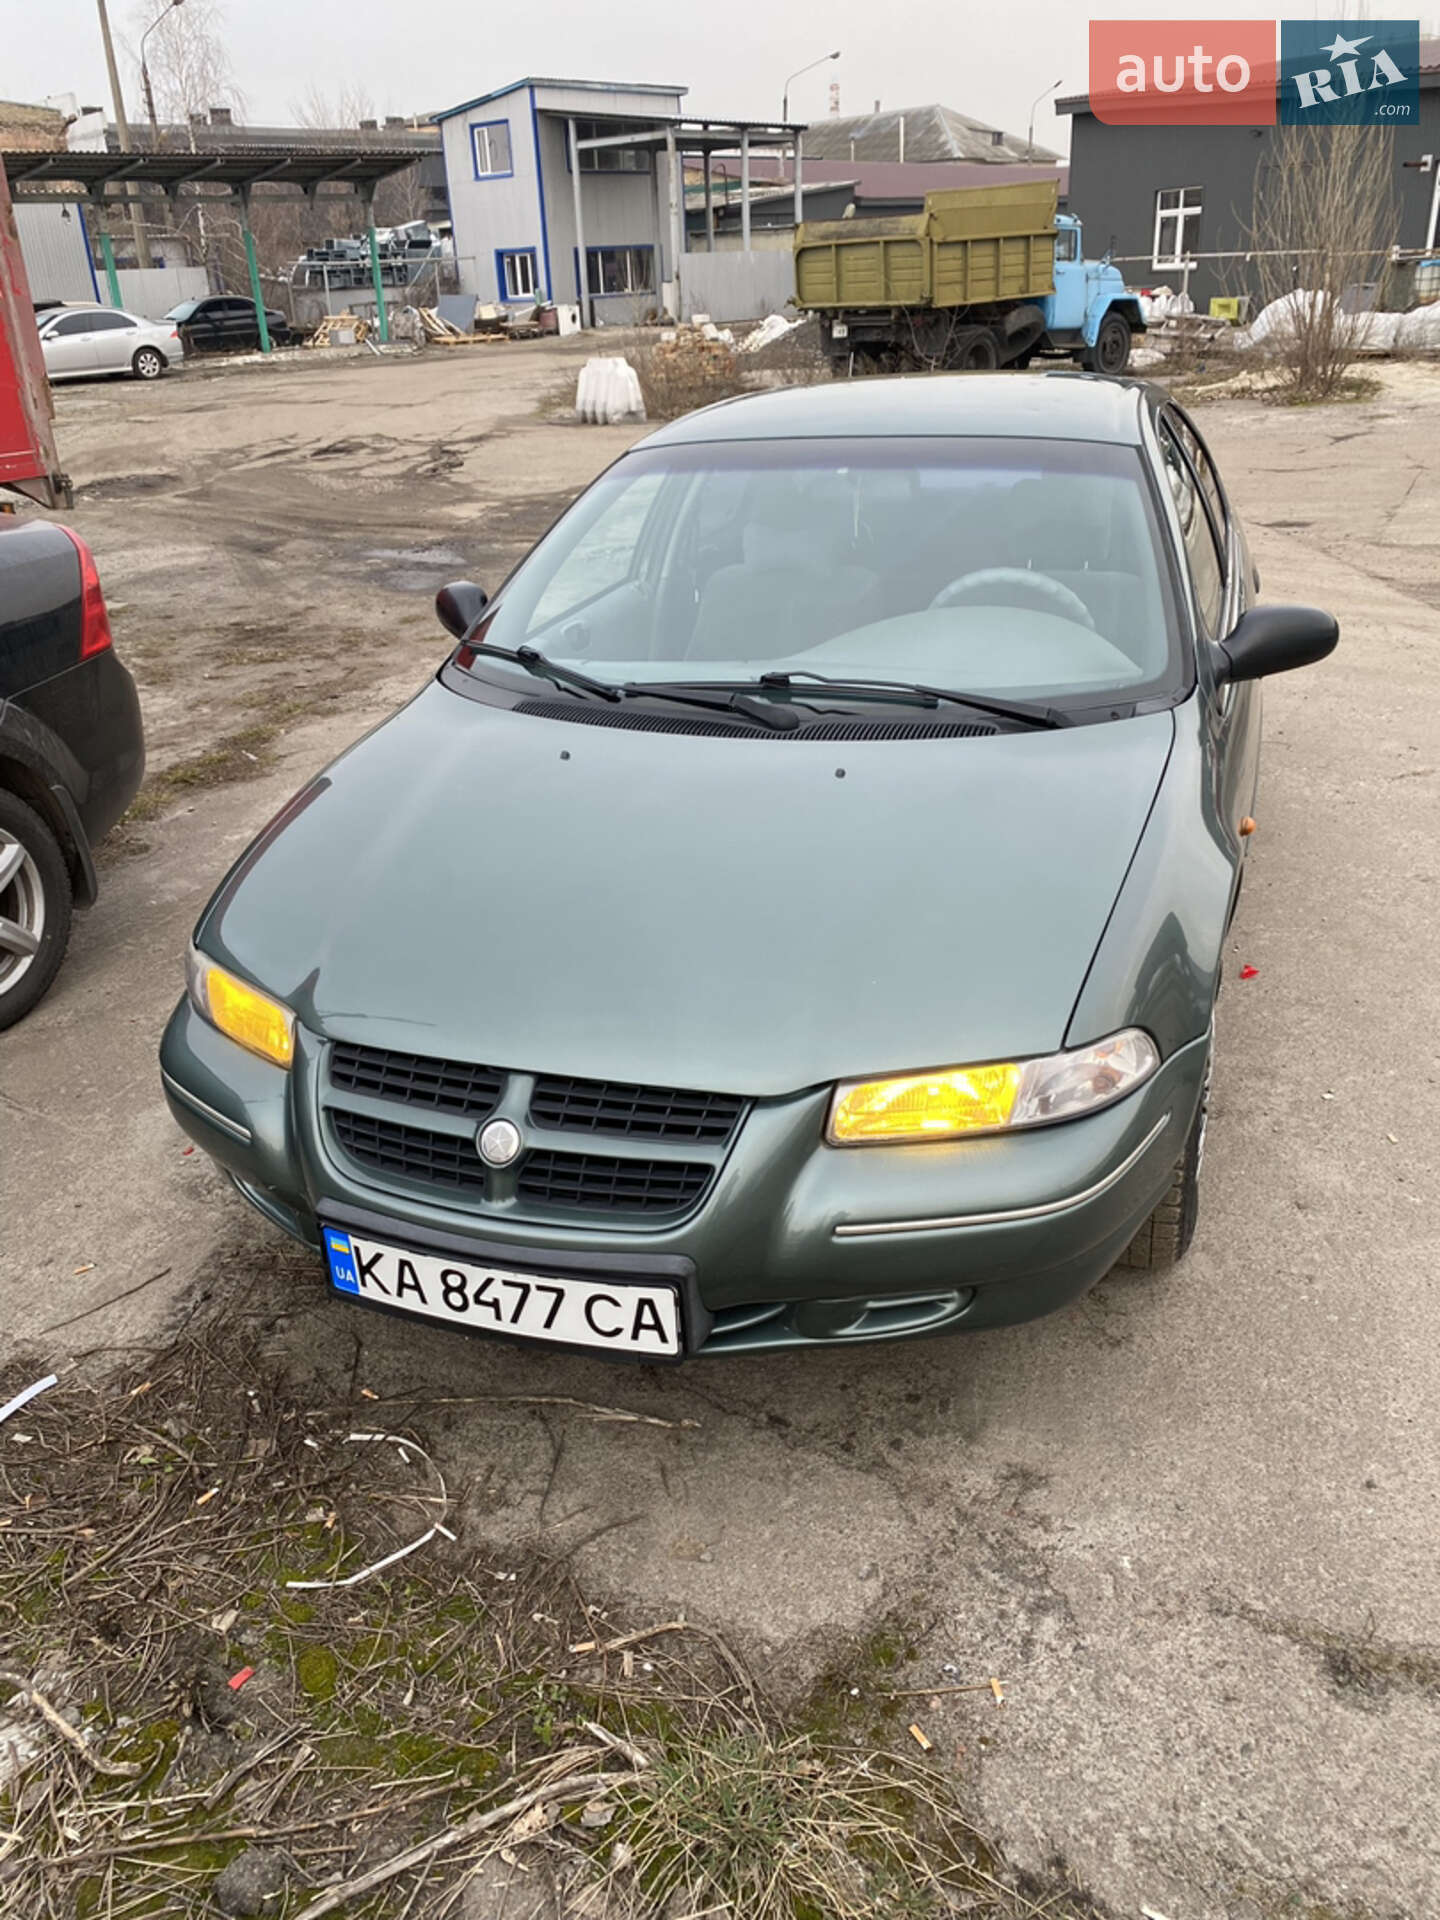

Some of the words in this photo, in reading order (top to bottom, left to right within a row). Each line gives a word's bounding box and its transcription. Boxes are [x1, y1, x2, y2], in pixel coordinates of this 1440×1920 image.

[335, 1264, 355, 1284] UA
[352, 1245, 428, 1305] KA
[440, 1269, 565, 1329] 8477
[583, 1293, 670, 1344] CA
